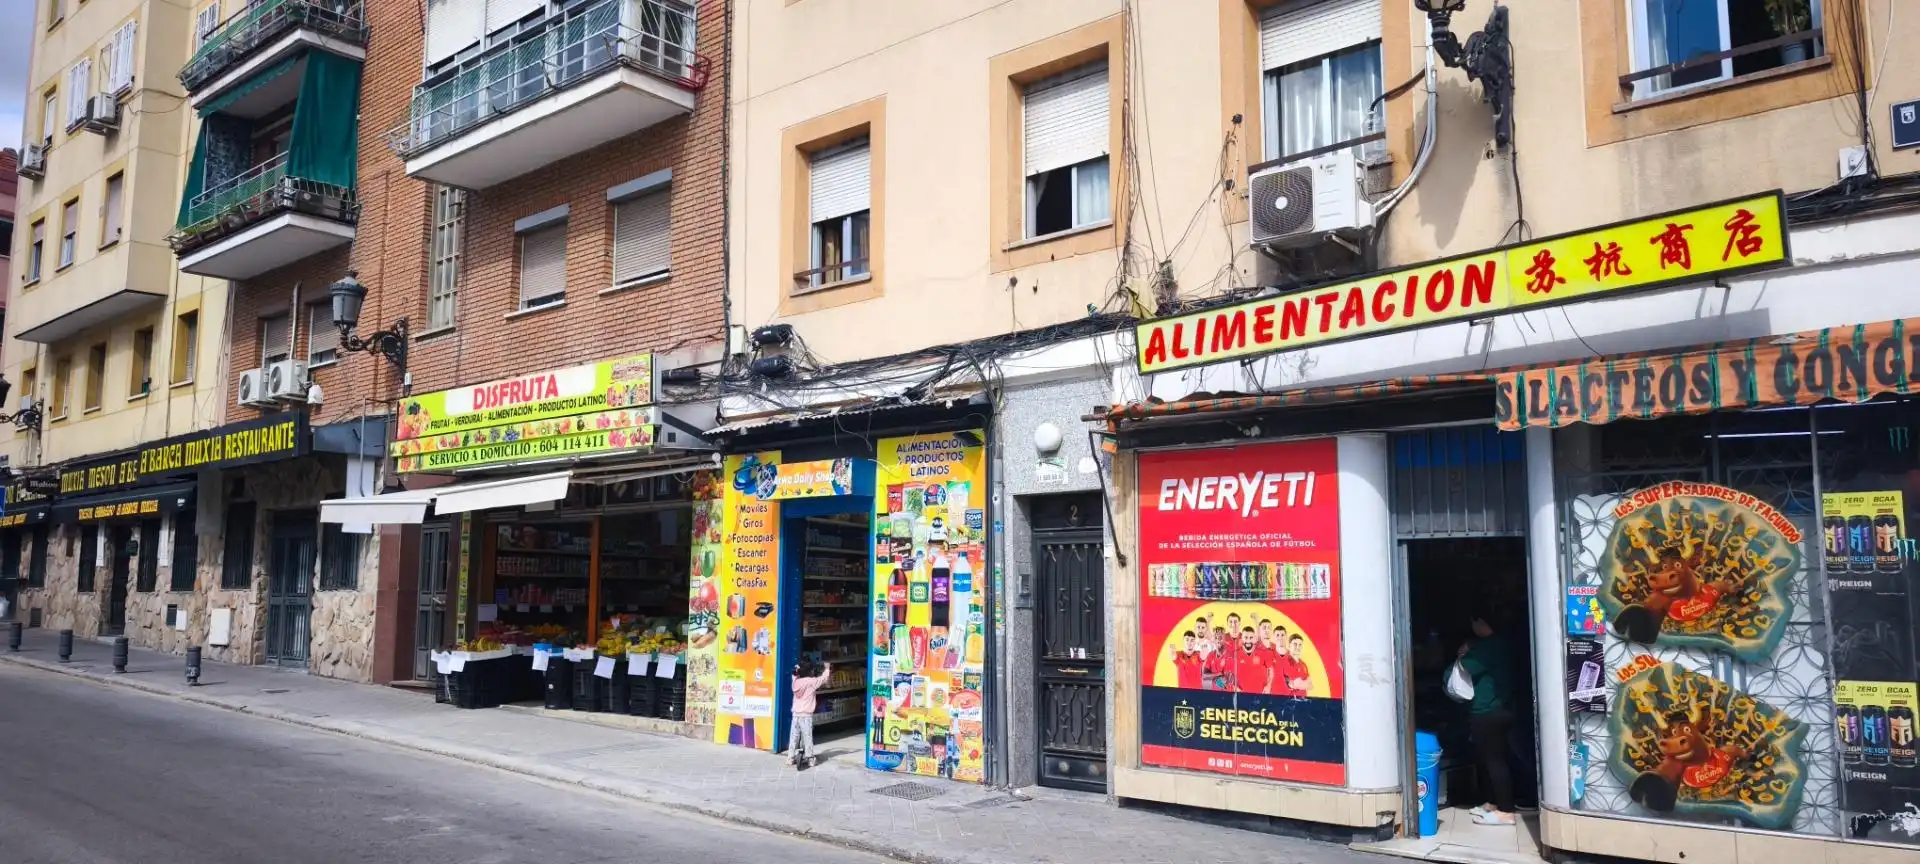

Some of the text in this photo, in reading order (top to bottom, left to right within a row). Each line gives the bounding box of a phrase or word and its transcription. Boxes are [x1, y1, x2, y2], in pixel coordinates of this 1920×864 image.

[1524, 208, 1763, 294] 苏杭商店
[1144, 260, 1496, 365] ALIMENTACION
[472, 374, 559, 410] DISFRUTA
[1528, 362, 1714, 418] LACTEOS
[1729, 357, 1757, 401] Y
[430, 418, 450, 430] FRUTAS
[454, 413, 483, 426] VERDURAS
[538, 398, 577, 413] PRODUCTOS
[578, 393, 607, 408] LATINOS
[225, 421, 295, 459] RESTAURANTE
[429, 449, 469, 466] SERVICIO
[471, 449, 478, 461] A
[480, 441, 531, 460] DOMICILIO
[539, 439, 558, 453] 604
[563, 436, 581, 450] 114
[585, 434, 604, 448] 411
[905, 450, 964, 465] PRODUCTOS
[910, 464, 950, 477] LATINOS
[1158, 470, 1316, 518] ENERYETI
[1070, 504, 1078, 520] 2
[1615, 501, 1634, 517] LOS
[1739, 493, 1756, 508] DE
[1755, 502, 1801, 542] FACUNDO
[743, 518, 763, 528] Giros
[732, 533, 774, 544] Fotocopias
[1226, 540, 1267, 549] ESPAÑOLA
[1260, 532, 1292, 540] OFICIAL
[737, 547, 767, 558] Escaner
[735, 562, 769, 574] Recargas
[1616, 664, 1637, 682] LOS
[1205, 707, 1278, 727] ENERGÍA
[1200, 722, 1304, 747] SELECCIÓN
[1852, 771, 1887, 780] REIGN
